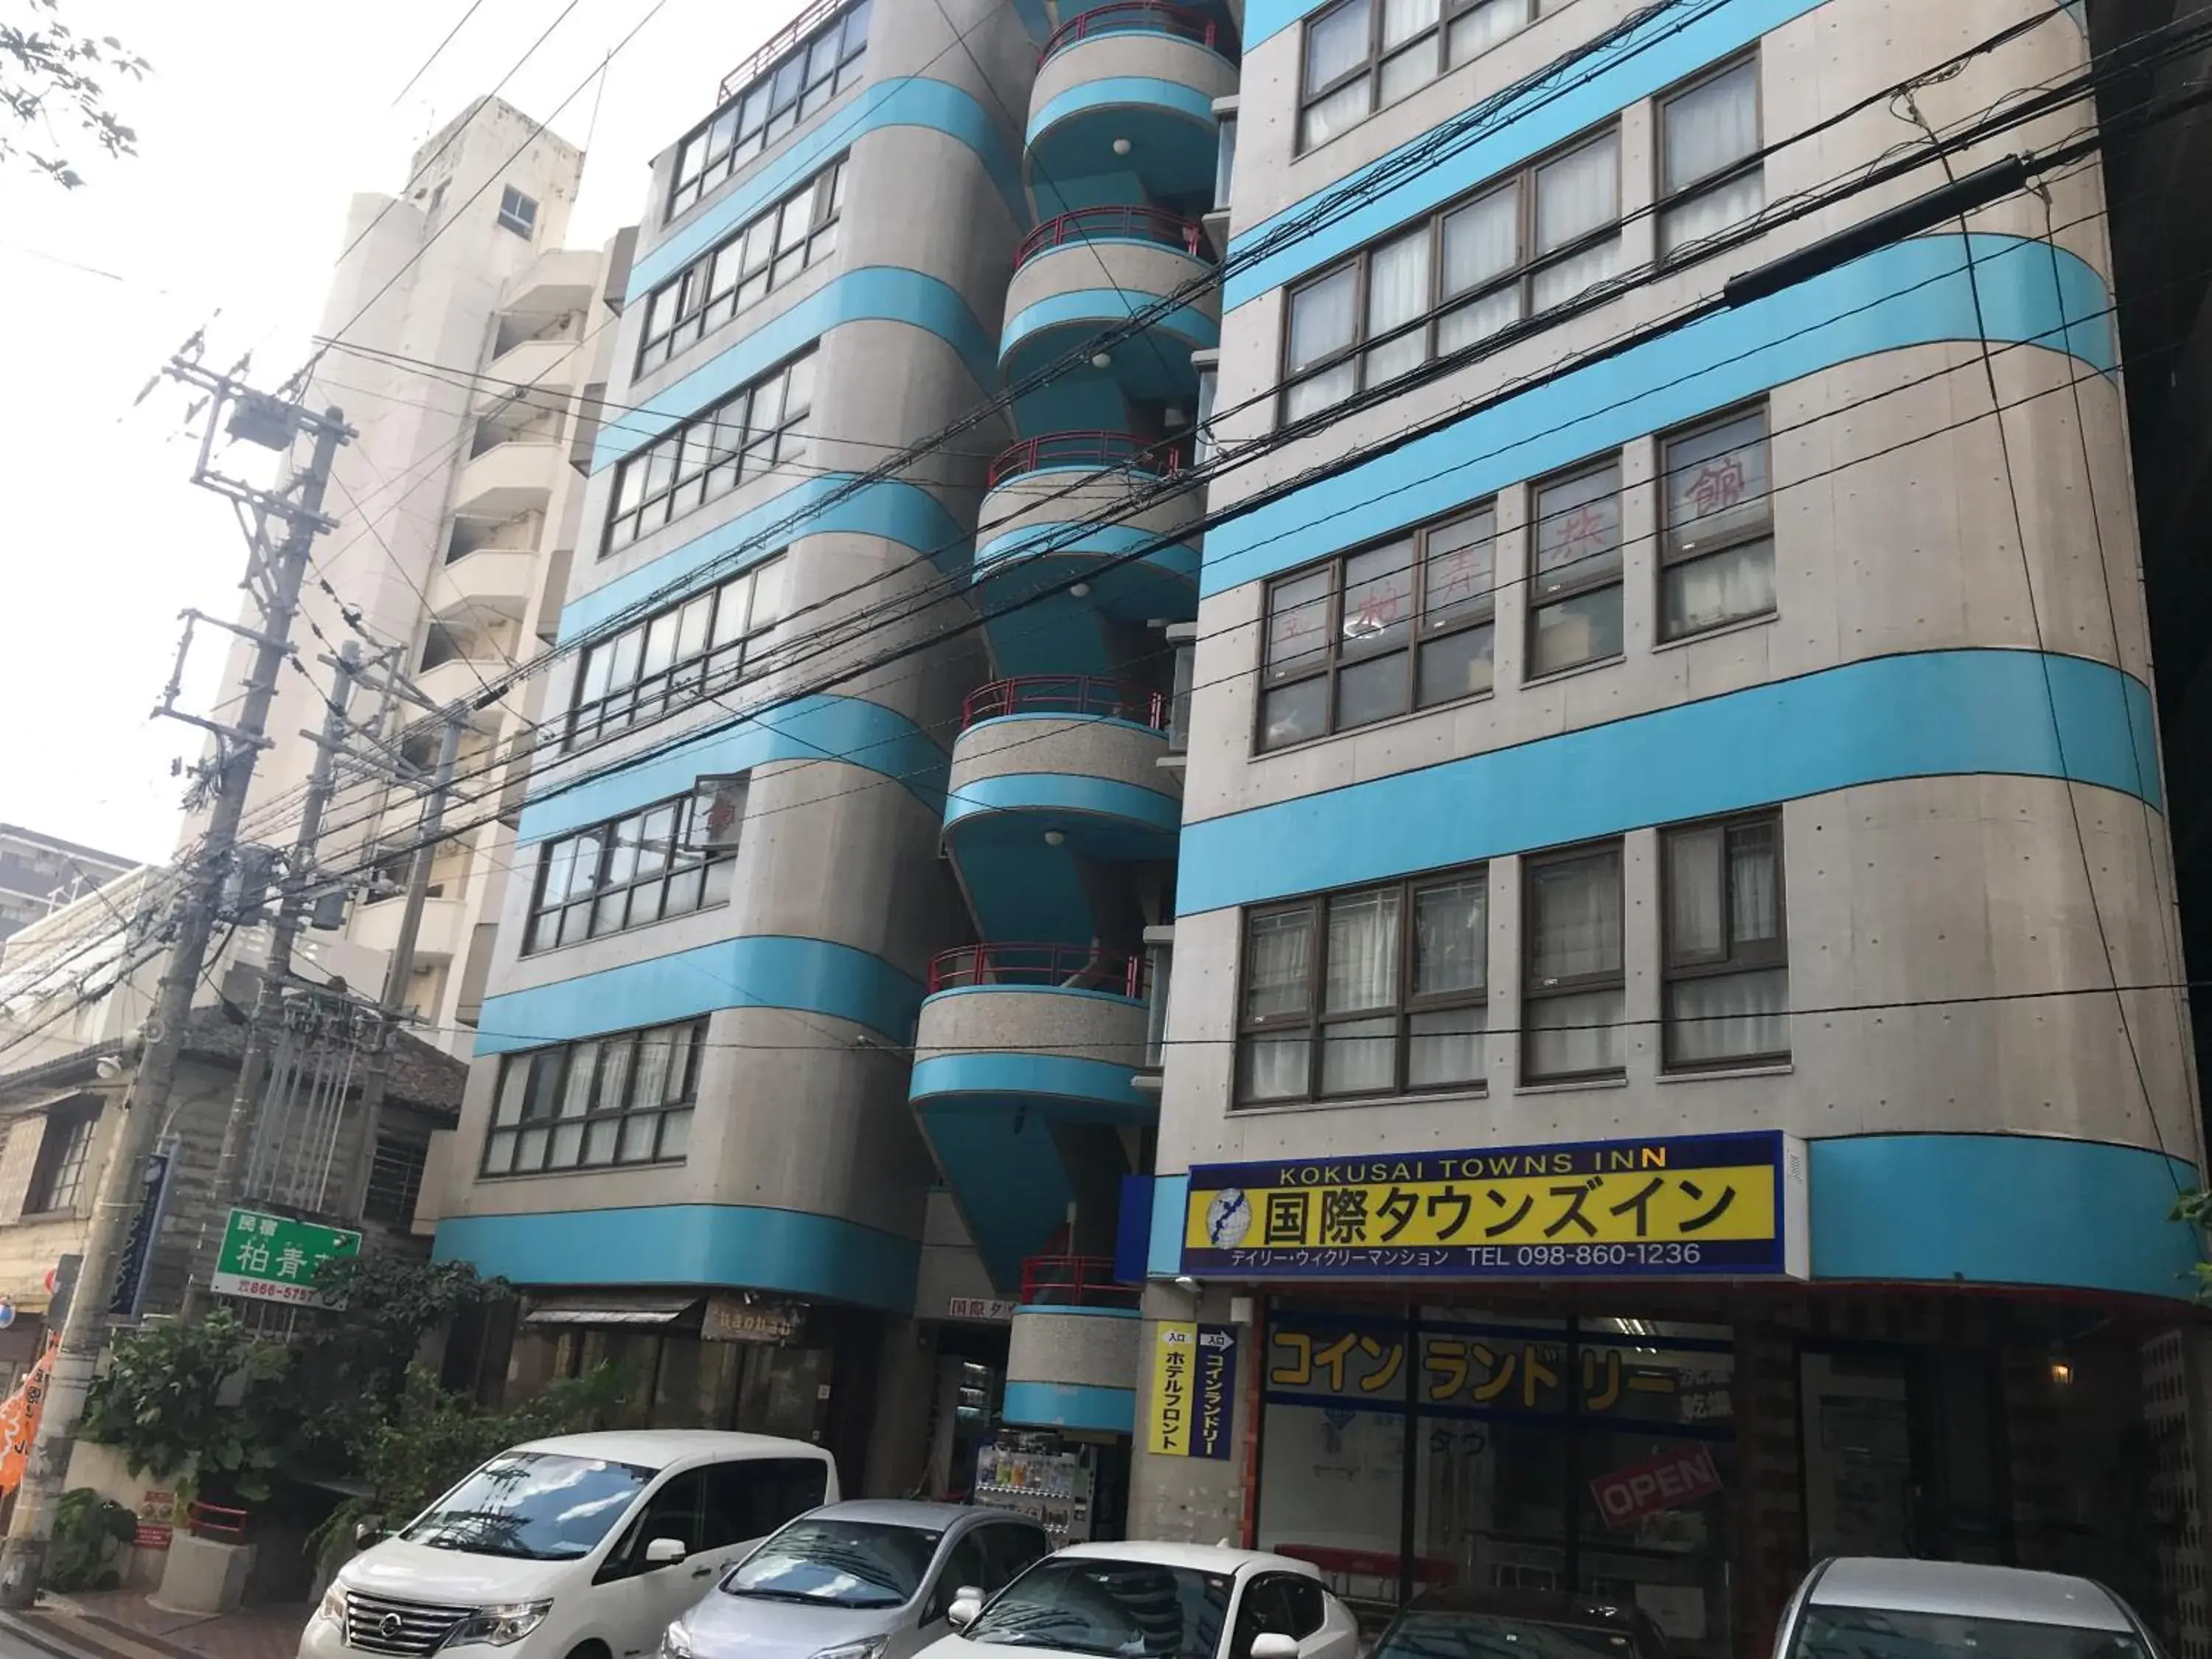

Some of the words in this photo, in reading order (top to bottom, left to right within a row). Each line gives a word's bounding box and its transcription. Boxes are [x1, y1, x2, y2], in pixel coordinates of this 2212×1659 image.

[1280, 1162, 1422, 1185] KOKUSAI
[1439, 1153, 1573, 1178] TOWNS
[1596, 1147, 1666, 1171] INN
[1264, 1175, 1737, 1245] 国際タウンズイン
[1467, 1246, 1510, 1266] TEL
[1517, 1243, 1701, 1265] 098-860-1236
[1169, 1332, 1185, 1343] 入口
[1208, 1335, 1225, 1346] 入口
[1162, 1352, 1186, 1450] ホテルフロント
[1270, 1332, 1675, 1411] コインランドリー
[1202, 1354, 1224, 1455] コインランドリー
[1603, 1453, 1712, 1514] OPEN
